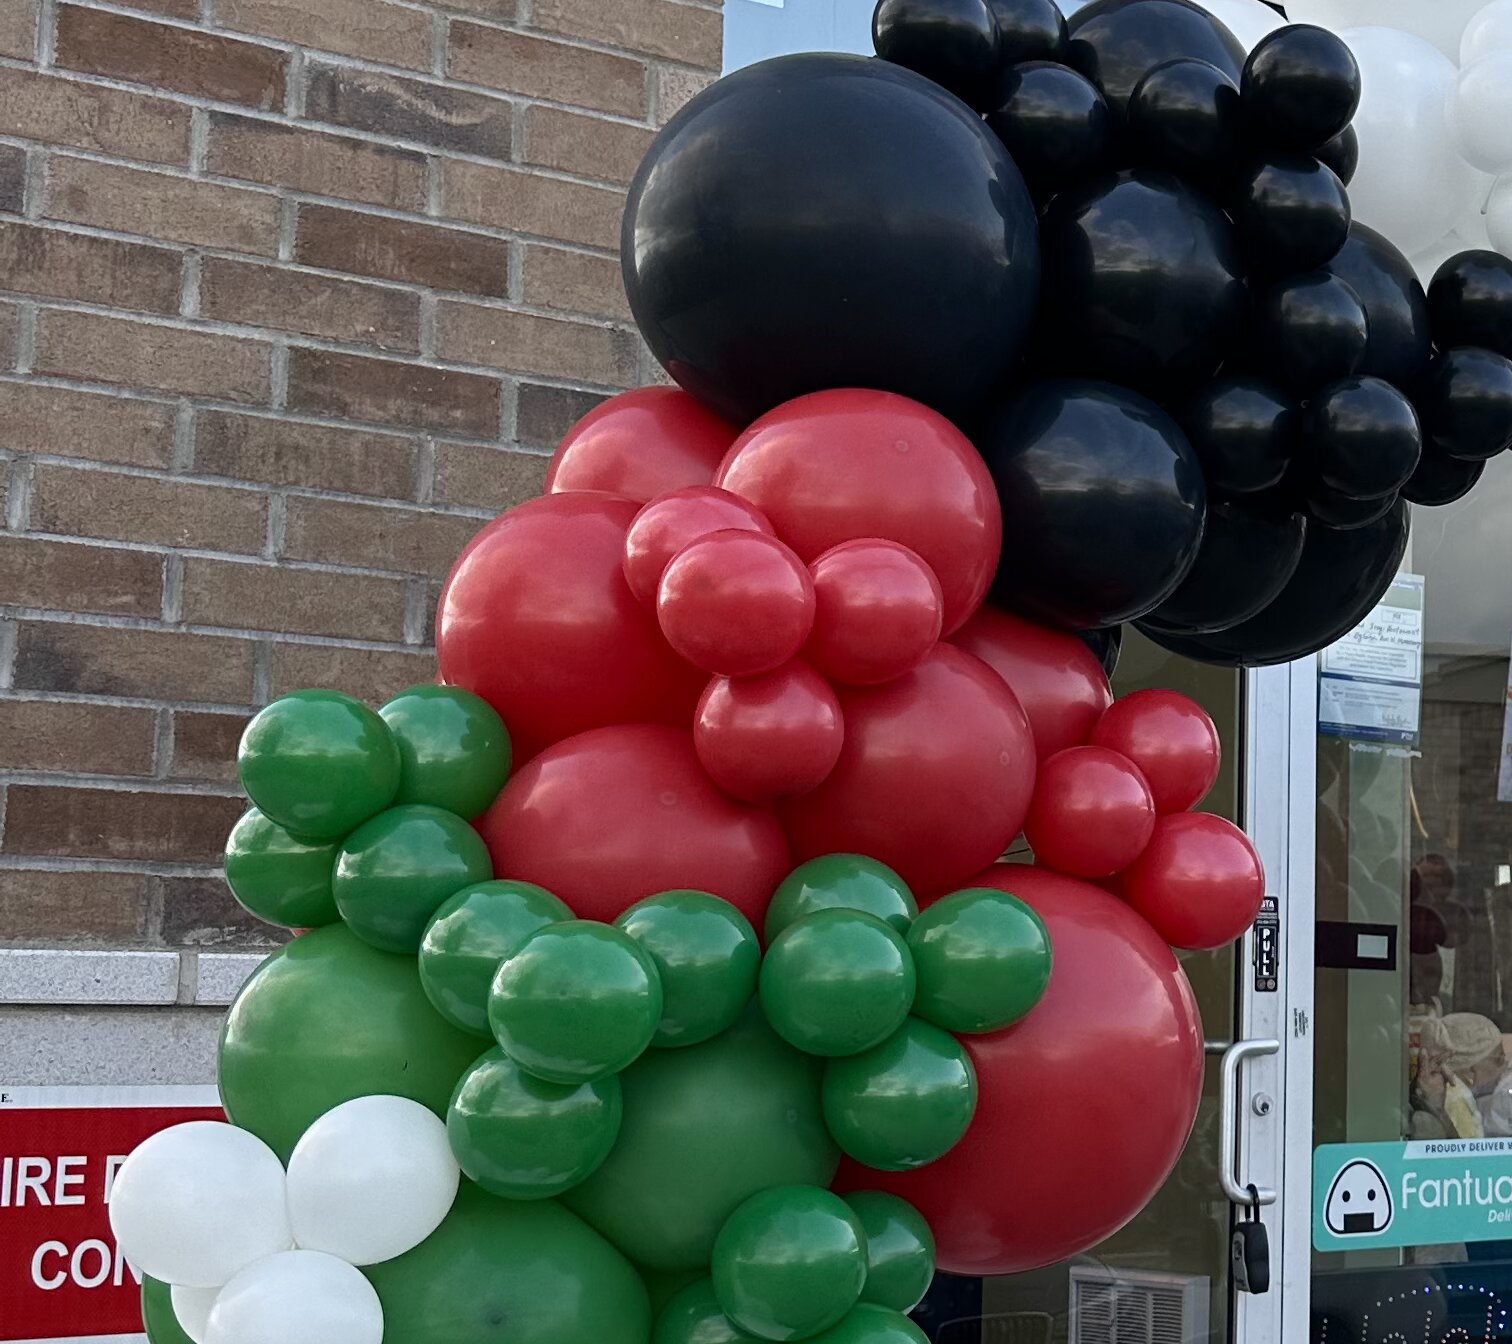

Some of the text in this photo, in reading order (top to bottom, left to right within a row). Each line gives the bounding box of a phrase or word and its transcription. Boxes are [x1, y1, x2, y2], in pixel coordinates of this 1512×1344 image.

[1262, 928, 1271, 976] PULL
[1425, 1142, 1466, 1154] PROUDLY
[1469, 1141, 1505, 1153] DELIVER
